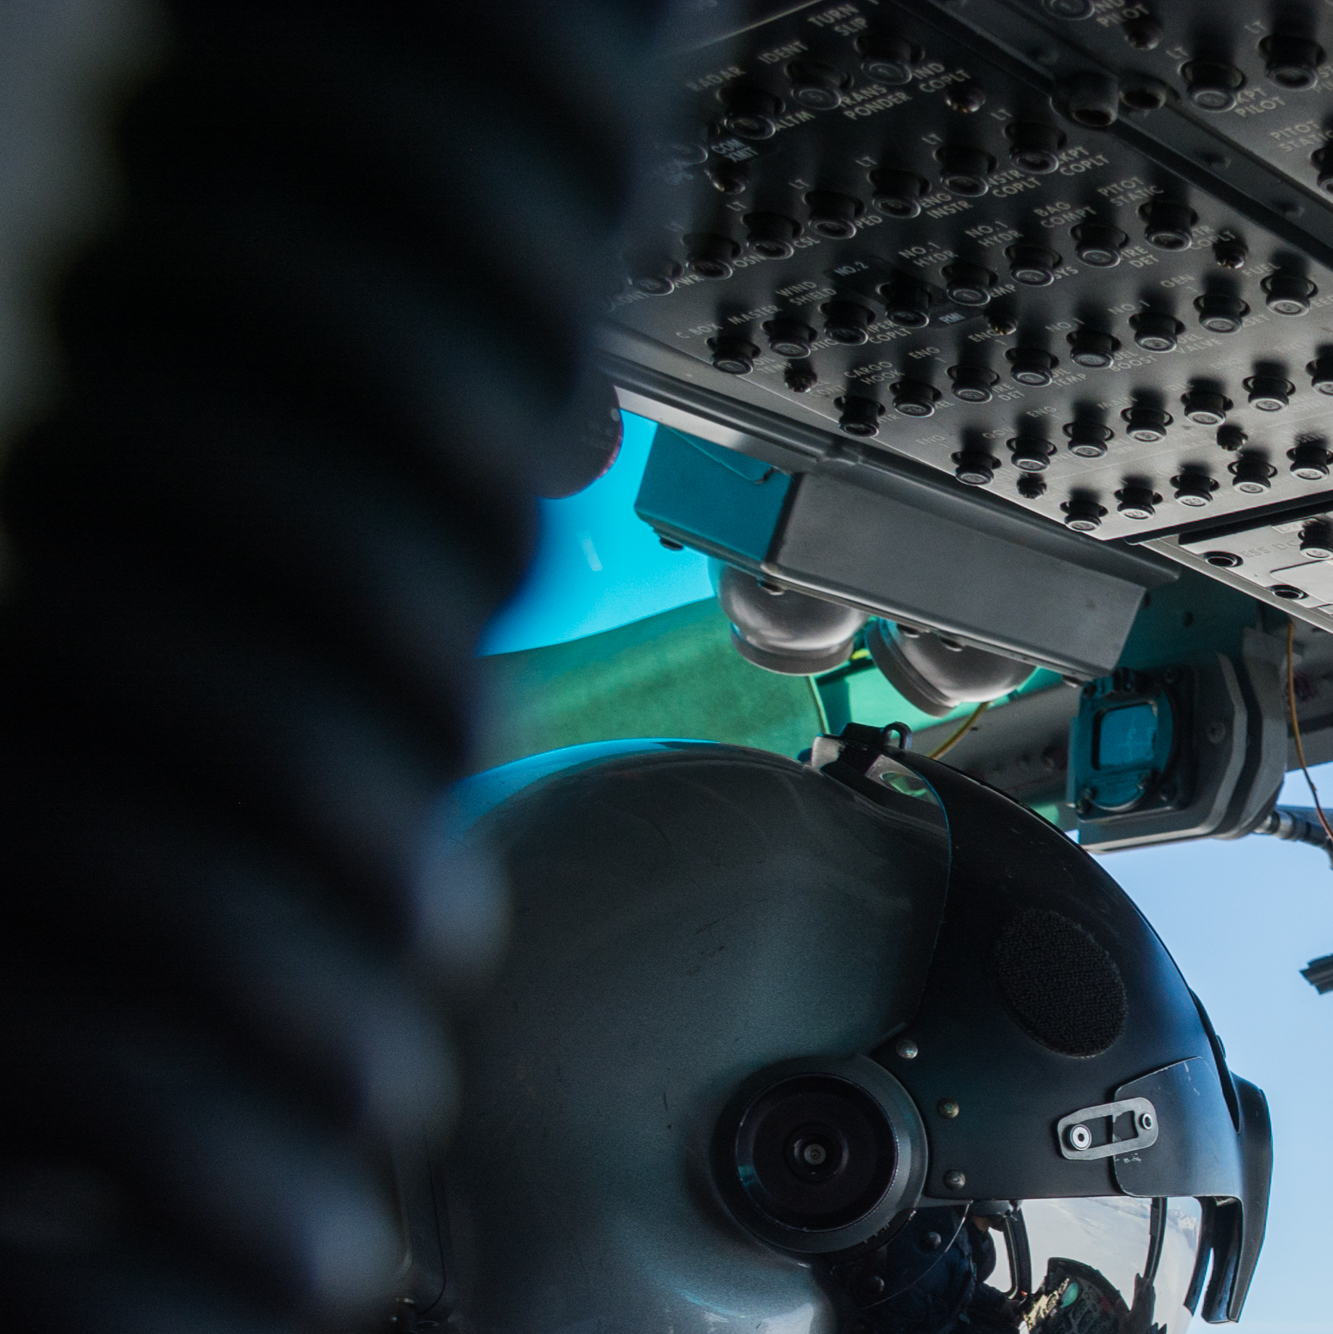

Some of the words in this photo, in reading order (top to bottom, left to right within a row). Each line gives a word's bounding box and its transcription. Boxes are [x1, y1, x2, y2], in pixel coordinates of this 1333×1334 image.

[808, 3, 860, 27] TURN
[834, 17, 868, 37] SLIP
[758, 41, 809, 65] IDENT
[920, 69, 972, 93] COPLT
[844, 91, 913, 120] PONDER
[1098, 177, 1145, 196] PITOT
[1109, 186, 1164, 206] STATIC
[1033, 202, 1071, 218] BAG
[1041, 206, 1097, 229] COMPT
[728, 304, 783, 325] MASTER
[844, 361, 893, 380] CARGO
[860, 369, 906, 385] HOOK
